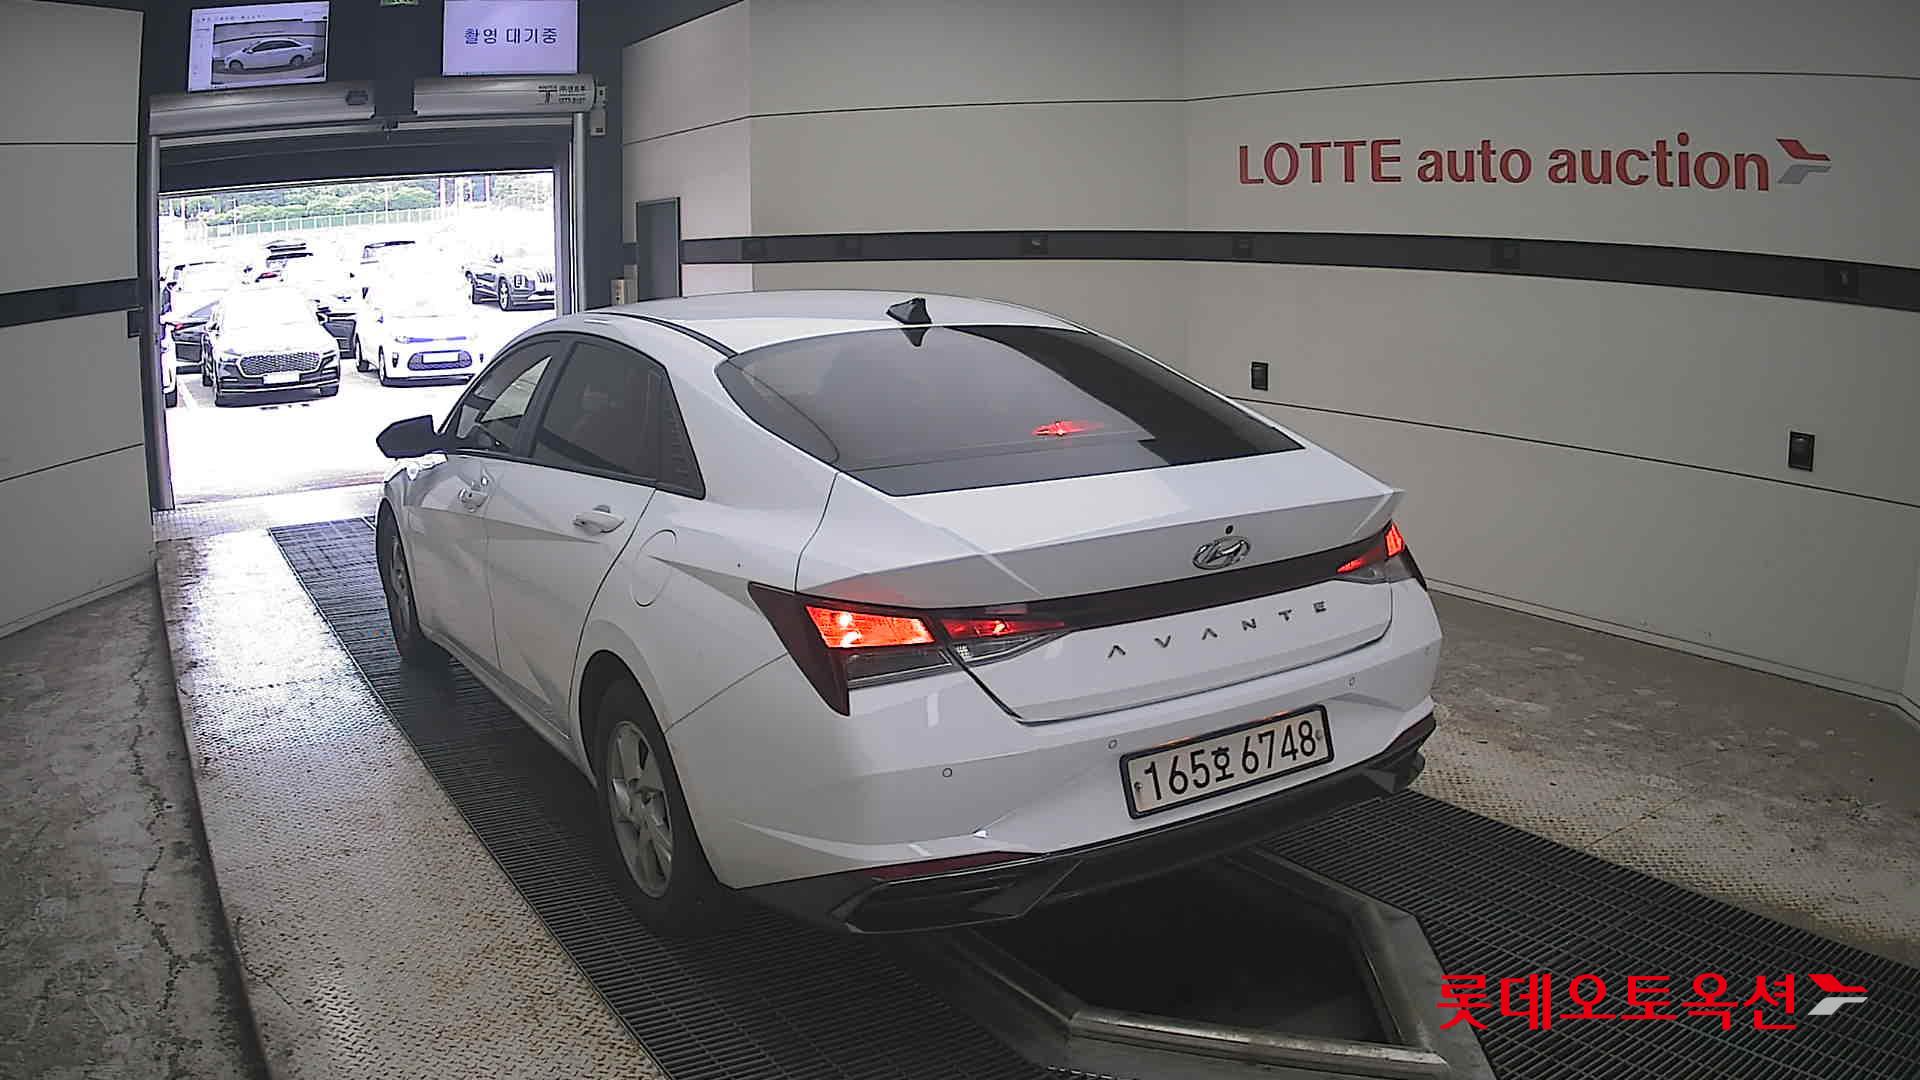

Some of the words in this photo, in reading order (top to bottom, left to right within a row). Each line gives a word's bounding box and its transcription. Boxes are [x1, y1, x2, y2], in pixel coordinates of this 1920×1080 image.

[506, 28, 558, 45] 대기중
[1239, 139, 1402, 186] LOTTE
[1417, 139, 1532, 184] auto
[1548, 132, 1769, 191] auction
[1107, 601, 1327, 659] AVANTE
[1143, 746, 1235, 801] 165호
[1241, 719, 1317, 775] 6748
